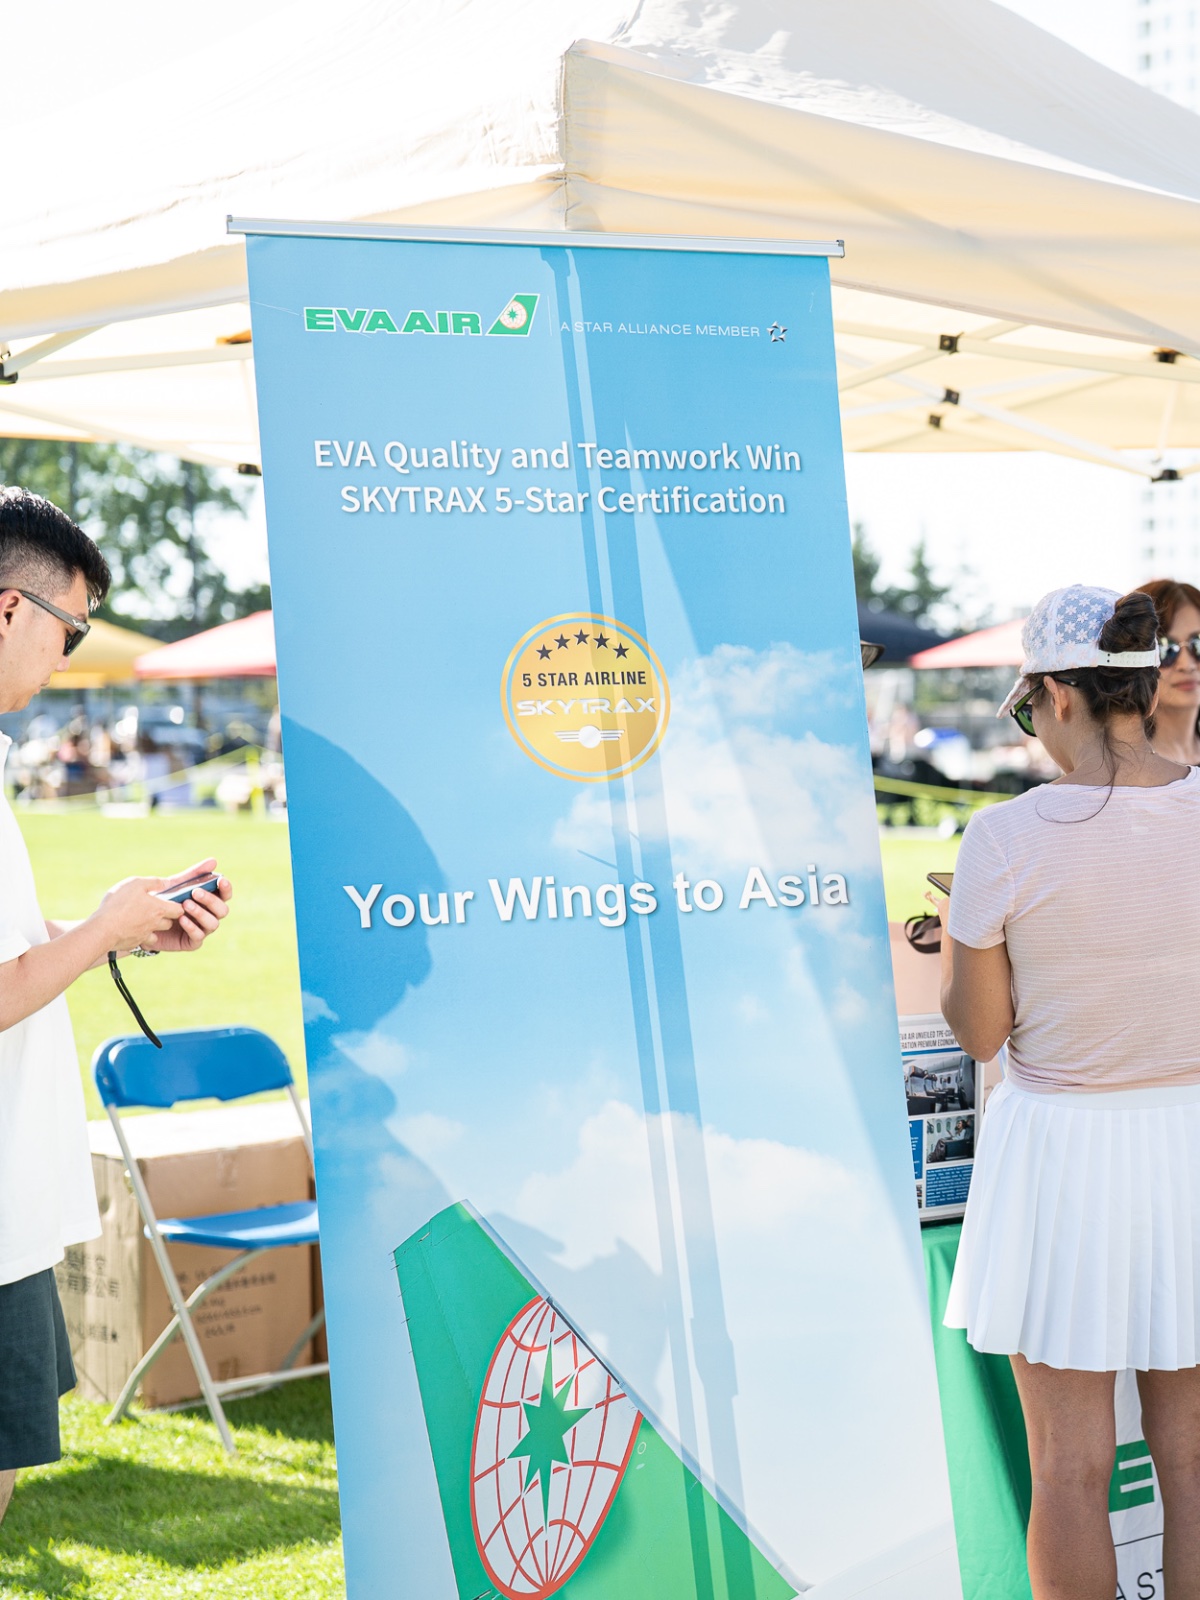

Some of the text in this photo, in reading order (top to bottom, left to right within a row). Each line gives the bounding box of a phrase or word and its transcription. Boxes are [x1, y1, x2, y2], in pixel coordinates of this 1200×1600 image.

[560, 321, 760, 337] A STAR ALLIANCE MEMBER
[314, 439, 801, 476] EVA Quality and Teamwork Win
[340, 485, 786, 514] SKYTRAX 5-Star Certification
[522, 671, 647, 687] 5 STAR AIRLINE
[516, 697, 656, 716] SKYTRAX
[342, 864, 849, 929] Your Wings to Asia
